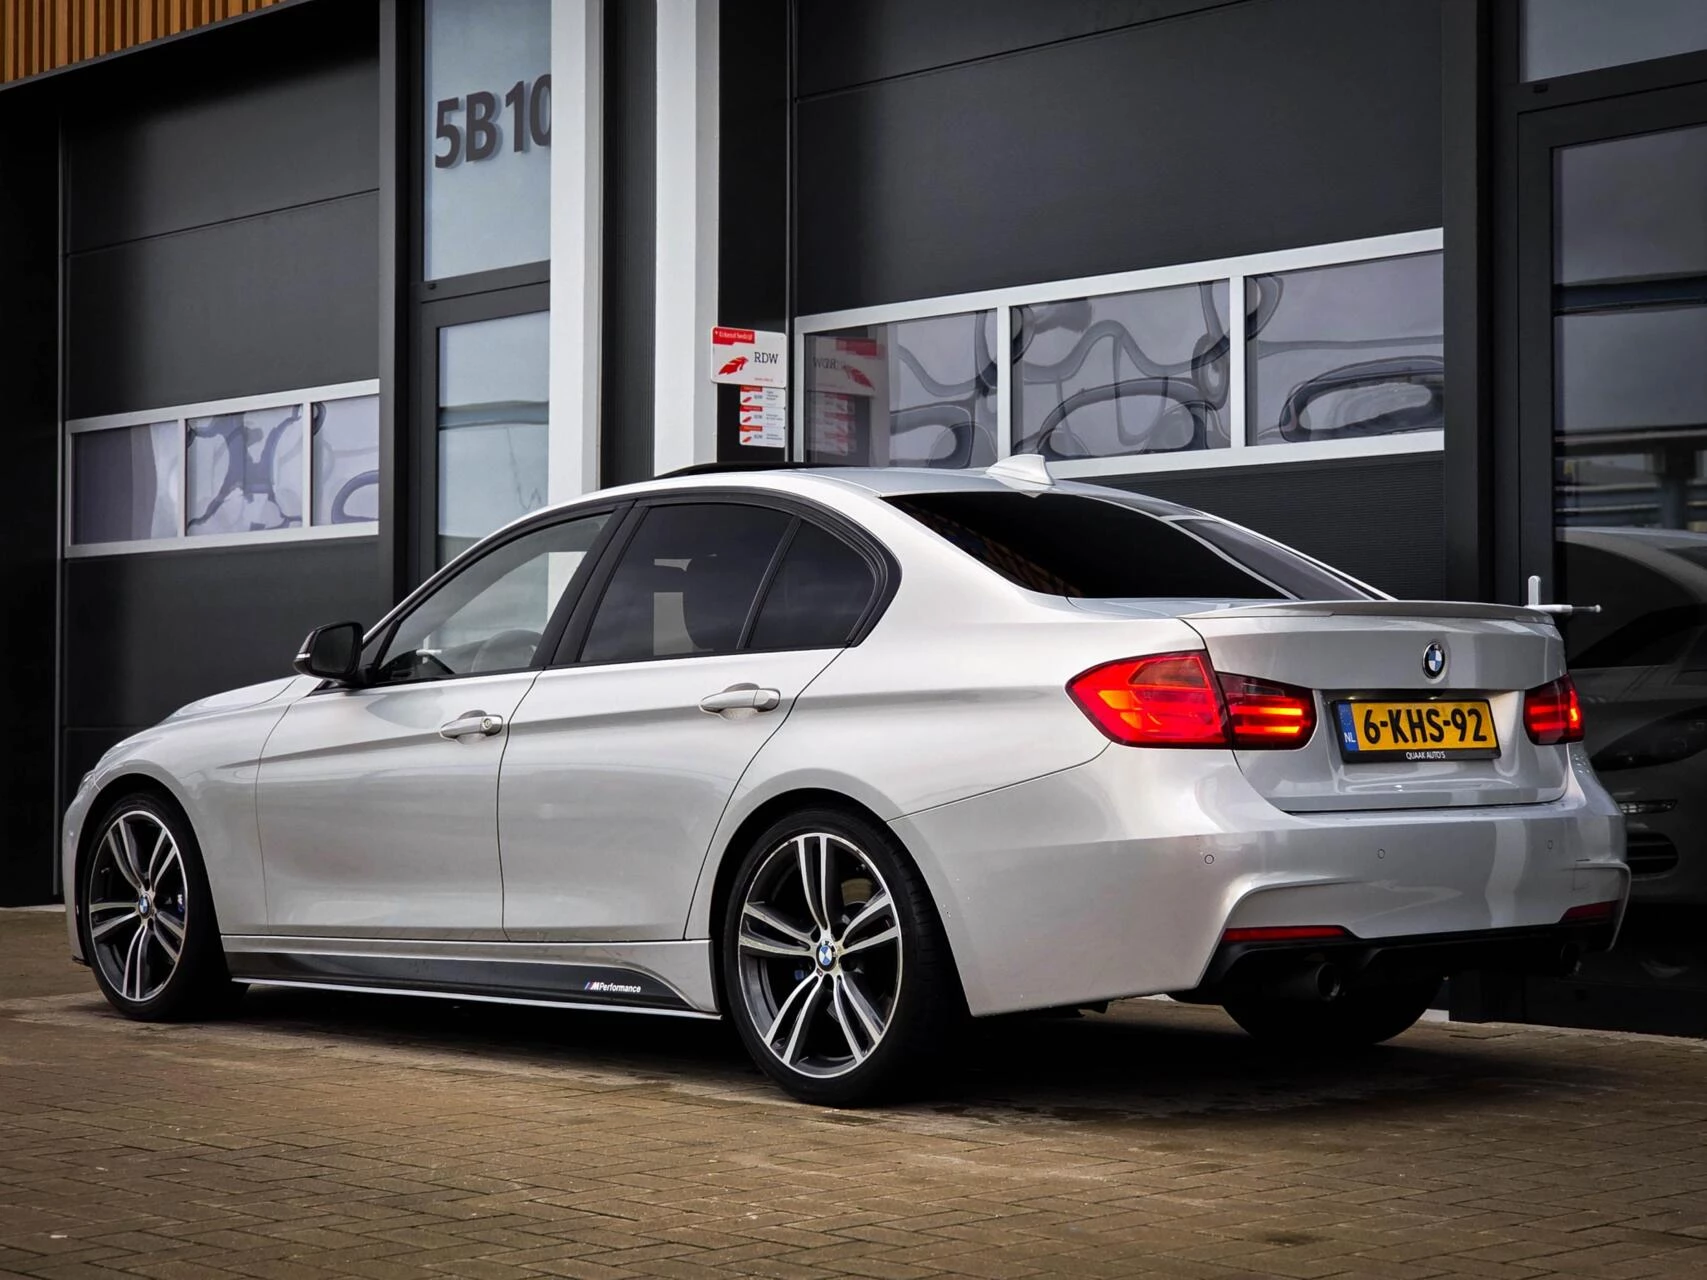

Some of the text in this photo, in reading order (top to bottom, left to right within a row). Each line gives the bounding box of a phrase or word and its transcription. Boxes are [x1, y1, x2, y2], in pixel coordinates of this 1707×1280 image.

[435, 74, 551, 168] 5B10
[754, 351, 779, 364] RDW
[1363, 708, 1488, 745] 6-KHS-92
[1343, 731, 1357, 744] NL
[1405, 751, 1426, 760] QUAAK
